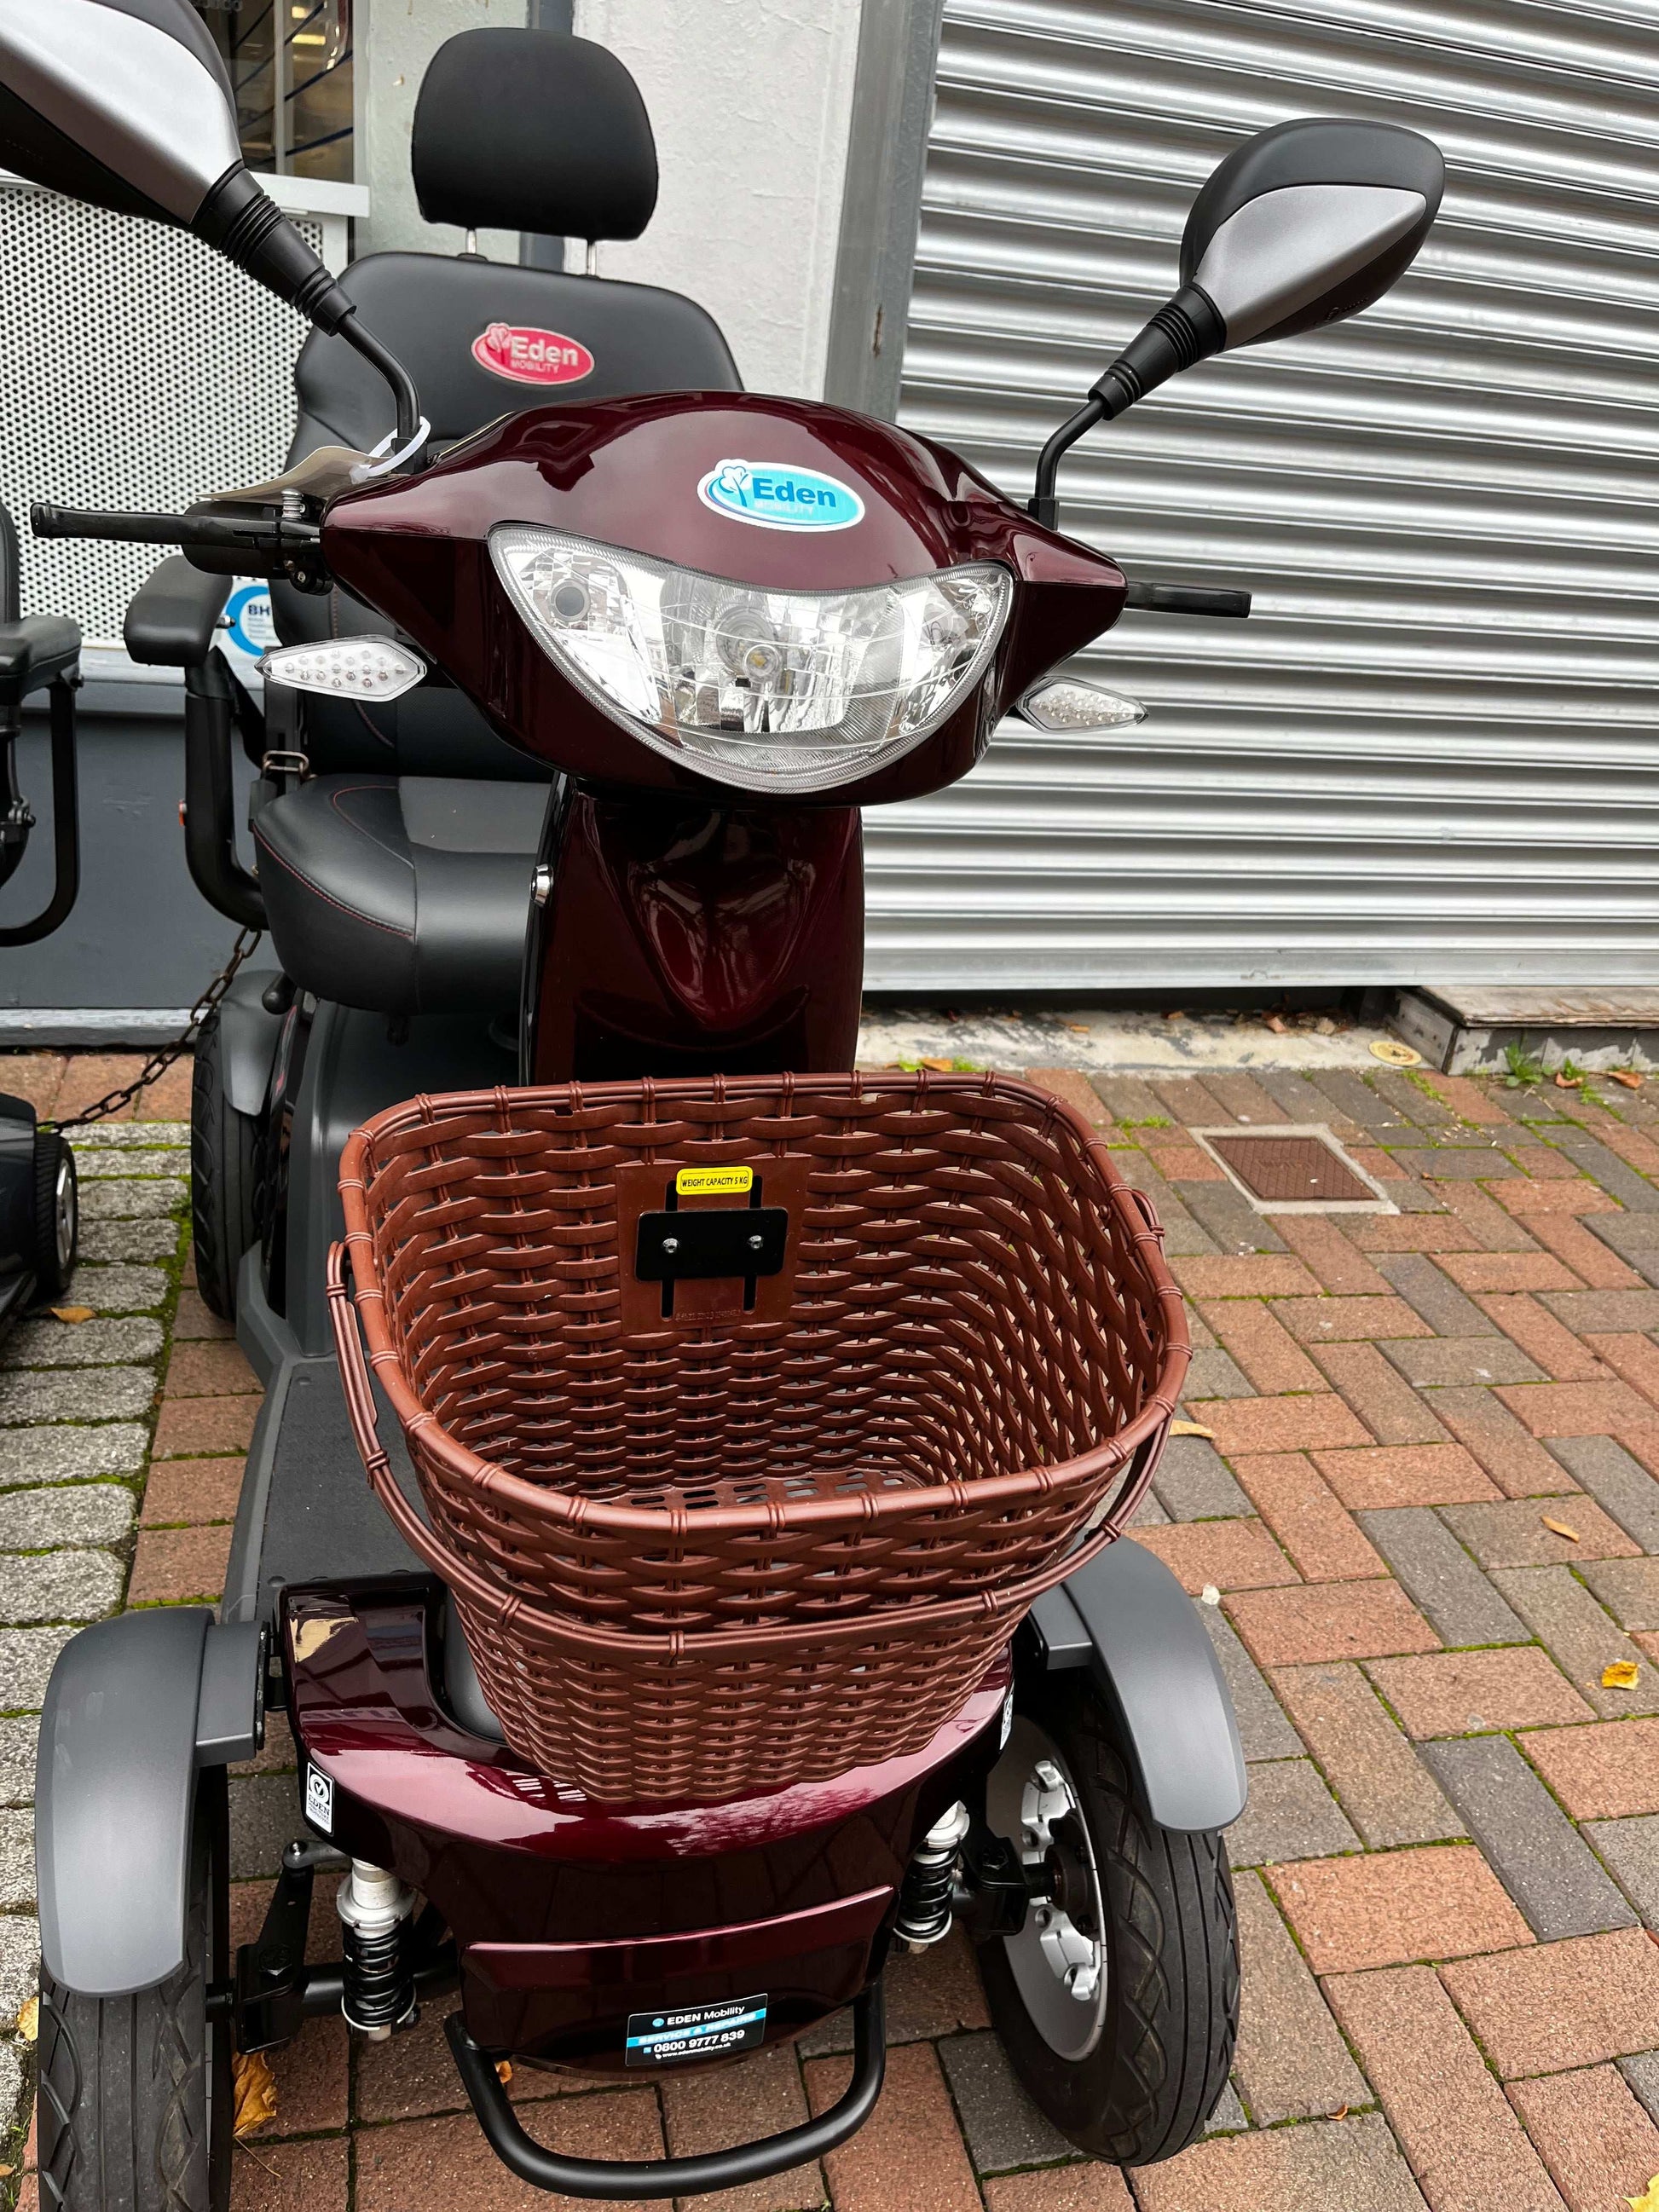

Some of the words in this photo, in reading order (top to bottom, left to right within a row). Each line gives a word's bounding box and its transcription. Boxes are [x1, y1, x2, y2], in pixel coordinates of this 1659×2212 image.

[511, 336, 578, 367] Eden
[511, 359, 559, 373] MOBILITY
[752, 477, 836, 507] Eden
[682, 1178, 705, 1187] WEIGHT
[706, 1177, 733, 1187] CAPACITY
[667, 2013, 701, 2025] EDEN
[704, 2006, 745, 2020] Mobility
[653, 2040, 686, 2053] 0800
[688, 2034, 720, 2047] 9777
[720, 2030, 745, 2042] 839
